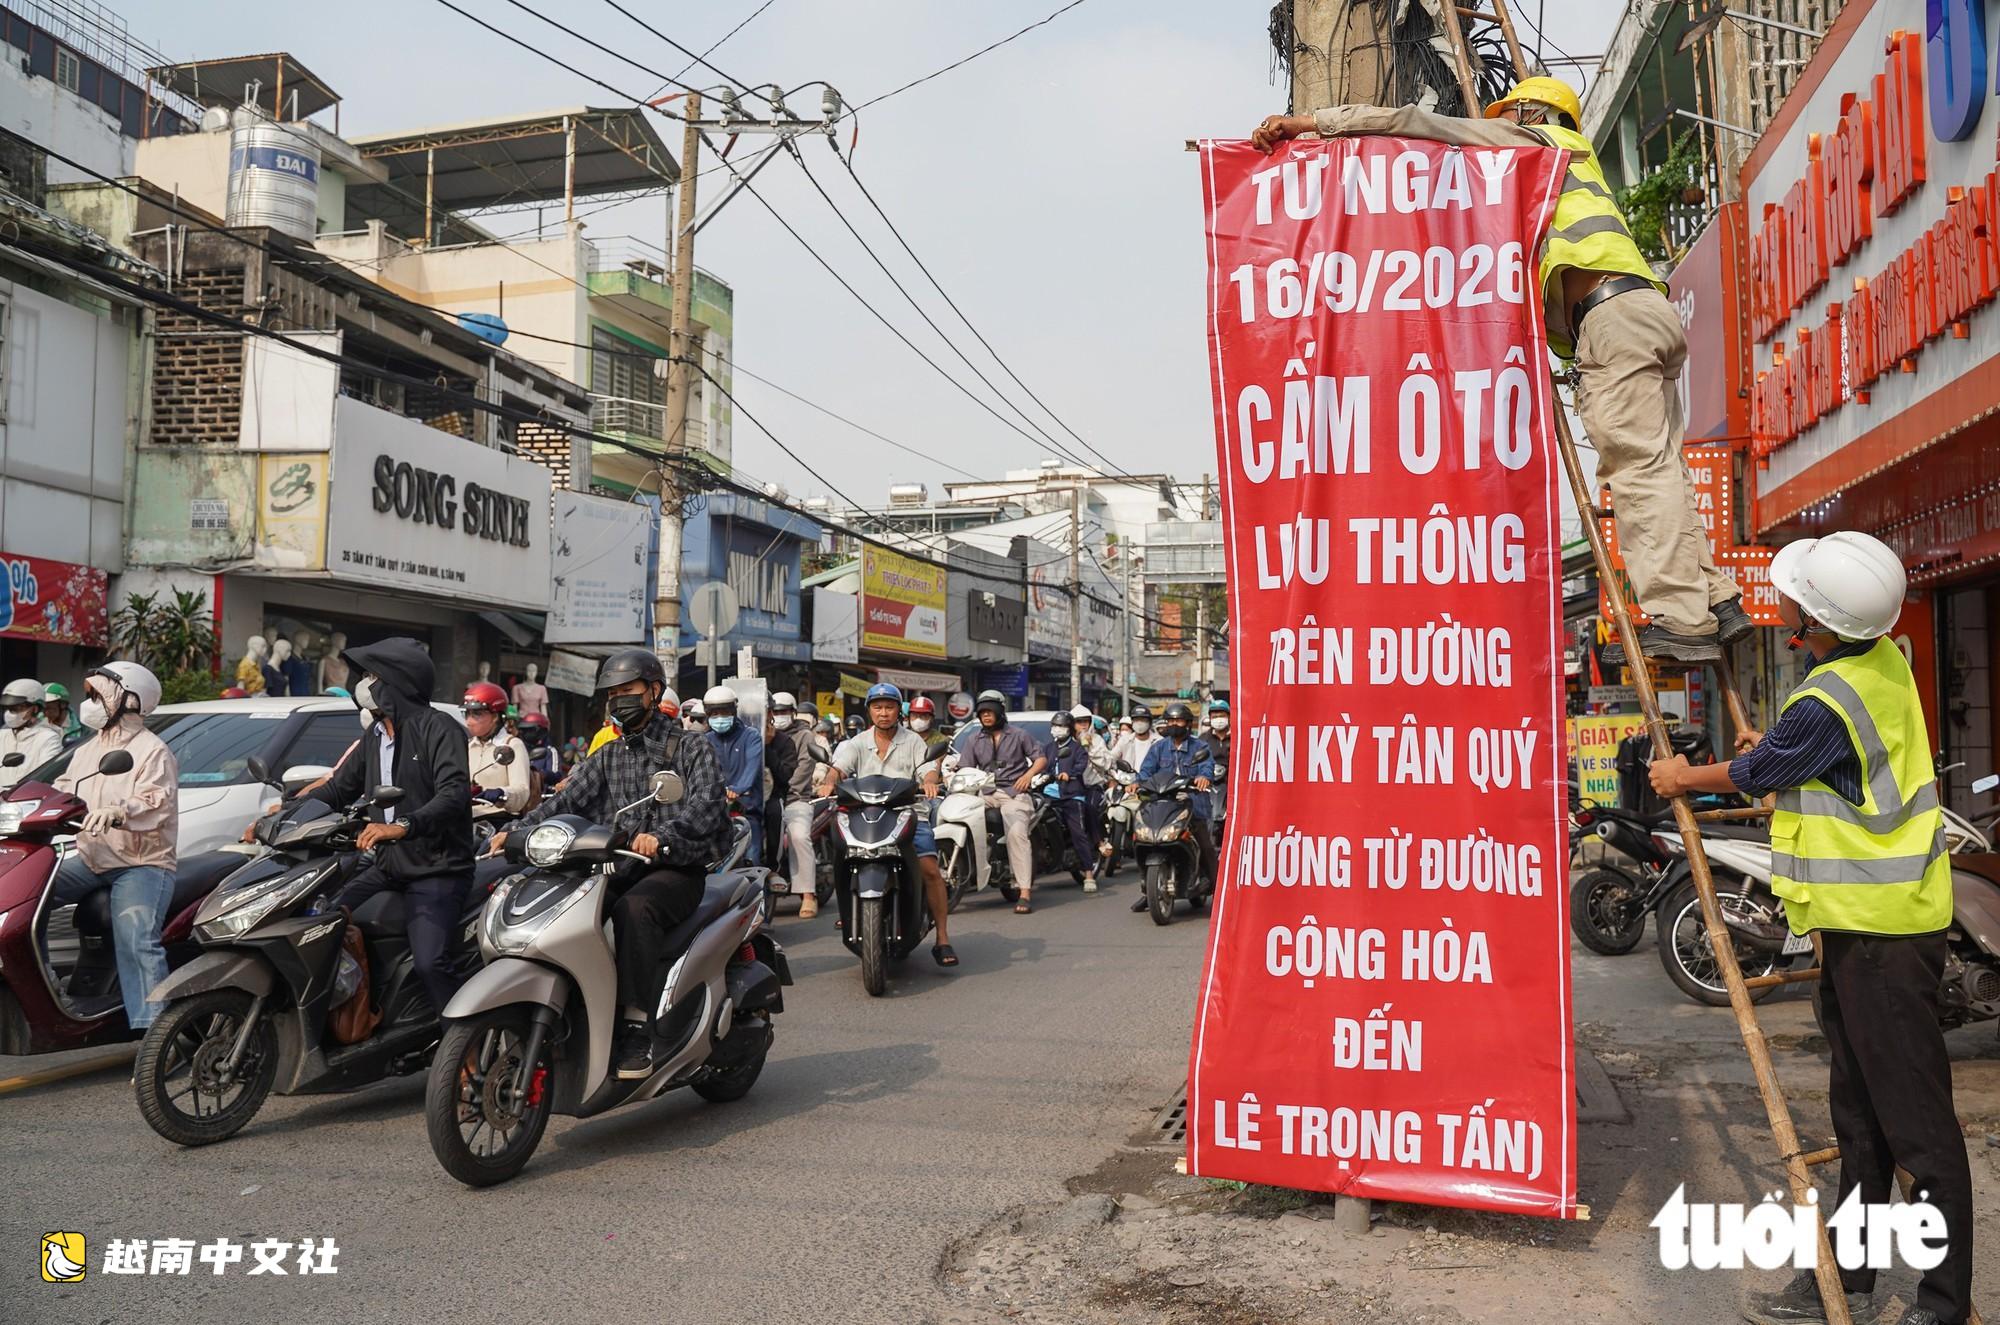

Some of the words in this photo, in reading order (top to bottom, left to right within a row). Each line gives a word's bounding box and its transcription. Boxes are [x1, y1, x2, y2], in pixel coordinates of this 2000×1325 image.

[1230, 241, 1525, 324] 16/9/2026
[1237, 341, 1371, 484] CẤM
[372, 454, 457, 529] SONG
[463, 482, 530, 548] SINH
[1255, 511, 1331, 591] LƯU
[1349, 502, 1526, 585] THÔNG
[1368, 612, 1512, 688] ĐƯỜNG
[1307, 713, 1360, 783] KỲ
[1372, 713, 1454, 784] TÂN
[1468, 717, 1538, 793] QUÝ
[1582, 754, 1596, 773] VỆ
[1363, 827, 1413, 890] TỪ
[1419, 827, 1543, 897] ĐƯỜNG
[1266, 914, 1386, 988] CỘNG
[1402, 917, 1493, 984] HÒA
[1332, 1002, 1422, 1072] ĐẾN
[1214, 1092, 1261, 1151] LÊ
[1276, 1104, 1422, 1170] TRỌNG
[1436, 1098, 1543, 1181] TẤN)
